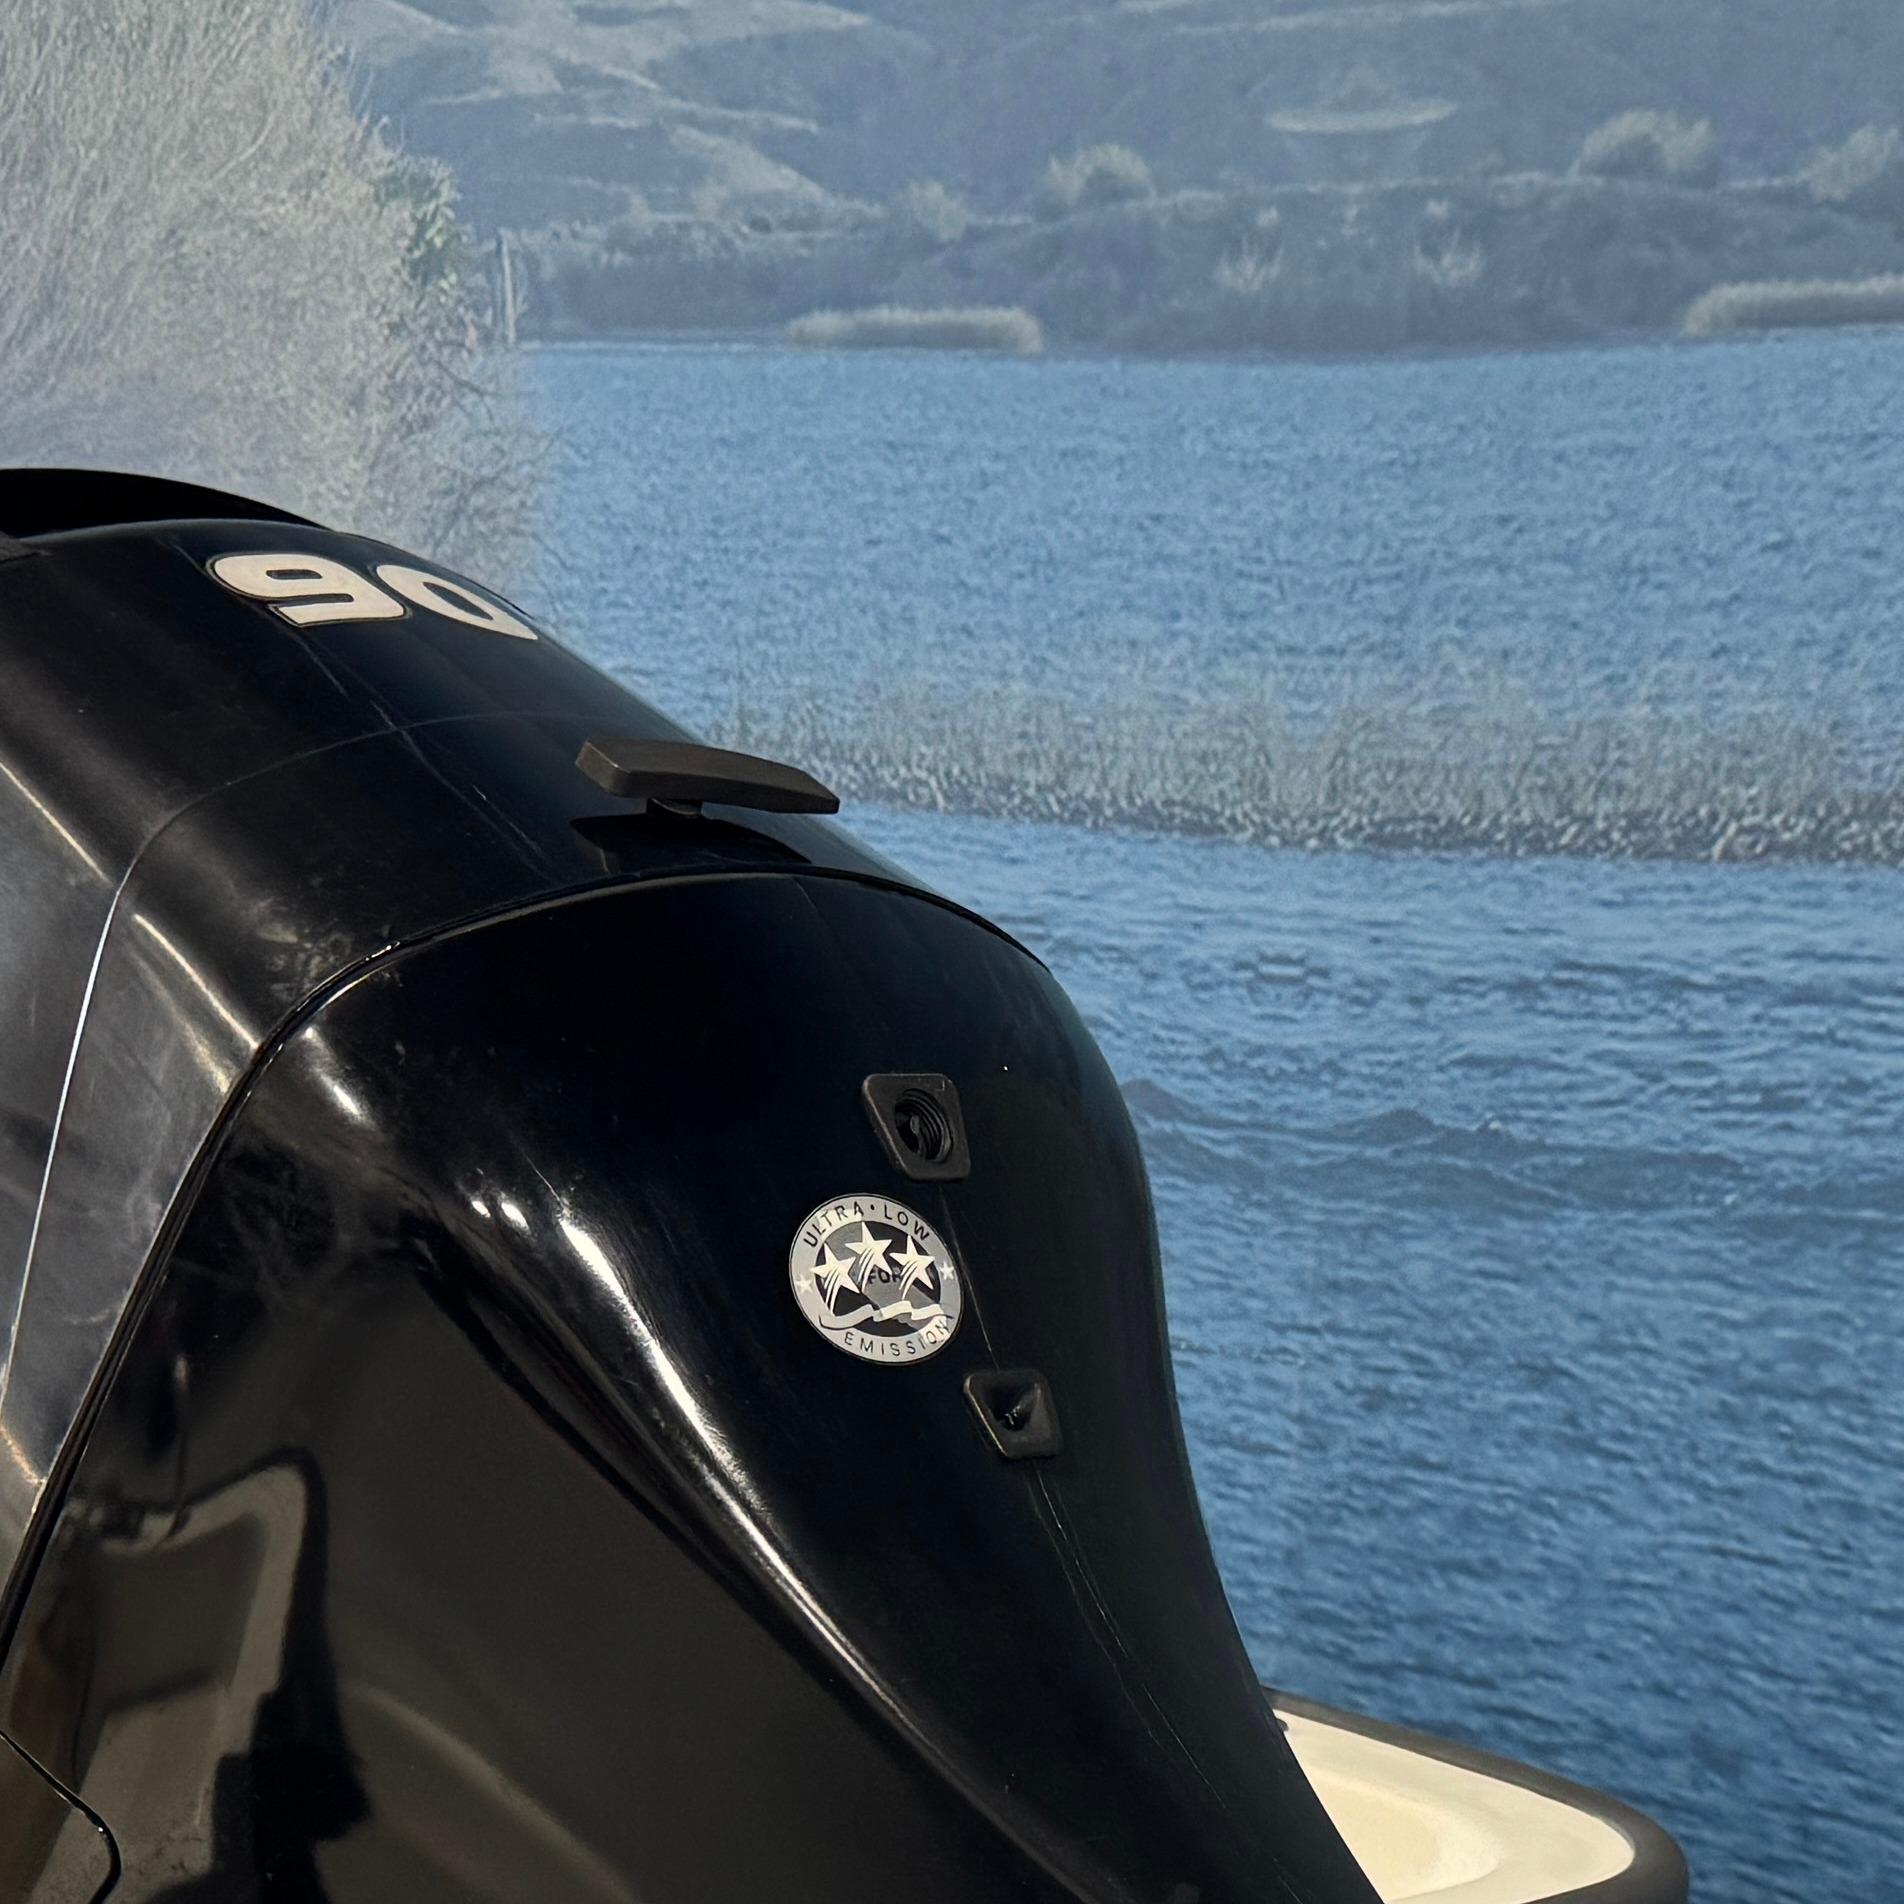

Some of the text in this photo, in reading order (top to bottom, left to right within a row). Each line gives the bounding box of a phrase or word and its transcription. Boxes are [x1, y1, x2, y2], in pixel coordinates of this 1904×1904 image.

[207, 552, 539, 627] 90
[803, 1201, 931, 1249] ULTRA LOW
[844, 1322, 950, 1357] EMISSION
